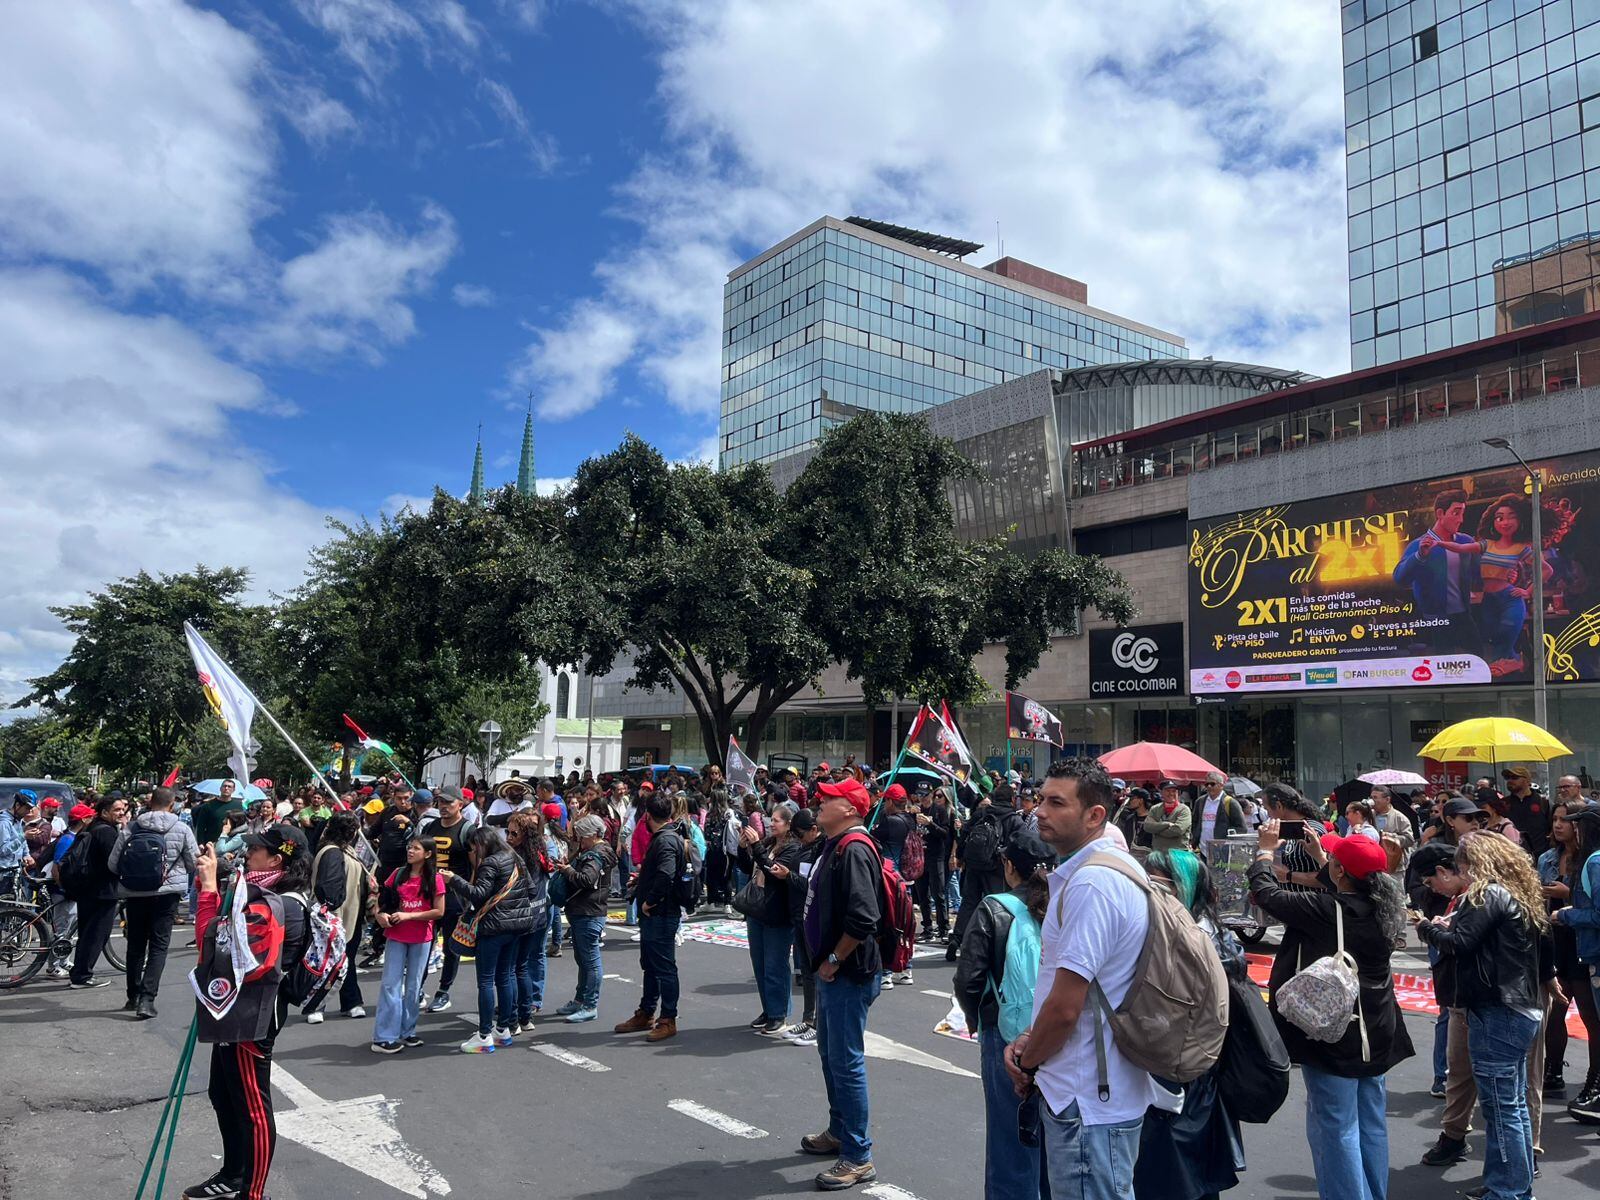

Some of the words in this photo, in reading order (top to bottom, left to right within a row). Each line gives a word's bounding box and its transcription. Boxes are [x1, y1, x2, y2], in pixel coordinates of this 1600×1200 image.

[1289, 553, 1321, 584] al
[1290, 596, 1301, 605] En
[1303, 595, 1315, 605] las
[1317, 591, 1356, 602] comidas
[1290, 604, 1309, 613] más
[1310, 603, 1326, 613] top
[1327, 601, 1340, 610] de
[1341, 600, 1350, 609] la
[1351, 597, 1382, 608] noche
[1236, 597, 1288, 626] 2X1
[1290, 612, 1311, 623] (Hall
[1312, 607, 1378, 620] Gastronómico
[1379, 604, 1401, 614] Piso
[1402, 603, 1413, 613] 4)
[1367, 622, 1400, 632] Jueves
[1409, 618, 1450, 628] sábados
[1227, 634, 1246, 642] Pista
[1247, 632, 1258, 640] de
[1259, 631, 1280, 639] baile
[1304, 627, 1335, 637] Música
[1395, 628, 1417, 637] P.M.
[1245, 639, 1265, 647] PISO
[1309, 636, 1322, 644] EN
[1323, 634, 1348, 642] VIVO
[1252, 649, 1308, 660] PARQUEADERO
[1309, 647, 1337, 657] GRATIS
[1436, 660, 1471, 670] LUNCH
[1352, 670, 1369, 678] FAN
[1369, 668, 1408, 678] BURGER
[1092, 680, 1116, 692] CINE
[1117, 677, 1177, 691] COLOMBIA
[1231, 757, 1290, 766] FREEPORT
[1430, 774, 1462, 785] SALE
